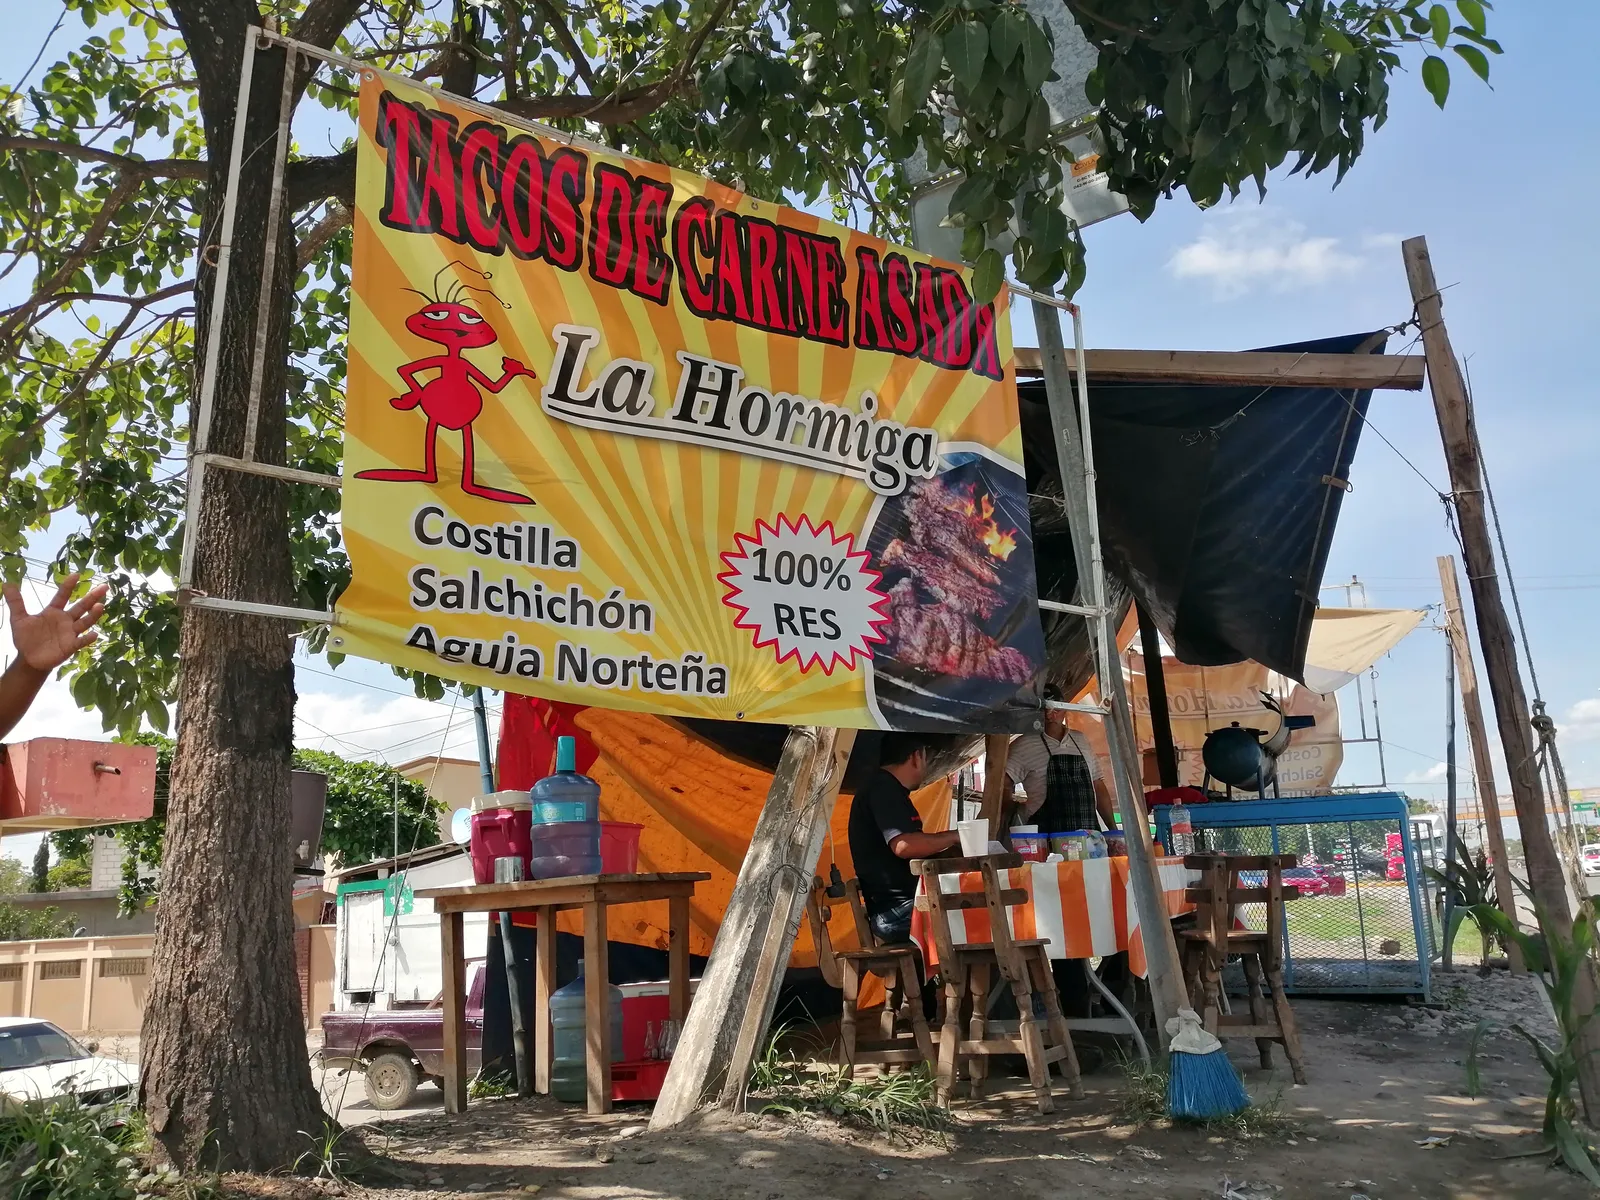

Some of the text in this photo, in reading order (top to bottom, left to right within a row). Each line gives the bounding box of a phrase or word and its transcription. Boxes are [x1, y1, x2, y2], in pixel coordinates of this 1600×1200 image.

[377, 92, 1003, 380] TACOS DE CARNE ASADA
[547, 331, 936, 490] La Hormiga
[413, 505, 578, 569] Costilla
[751, 547, 852, 592] 100%
[411, 567, 652, 632] Salchichón
[773, 602, 842, 640] RES
[406, 626, 727, 695] Aguja Norteña
